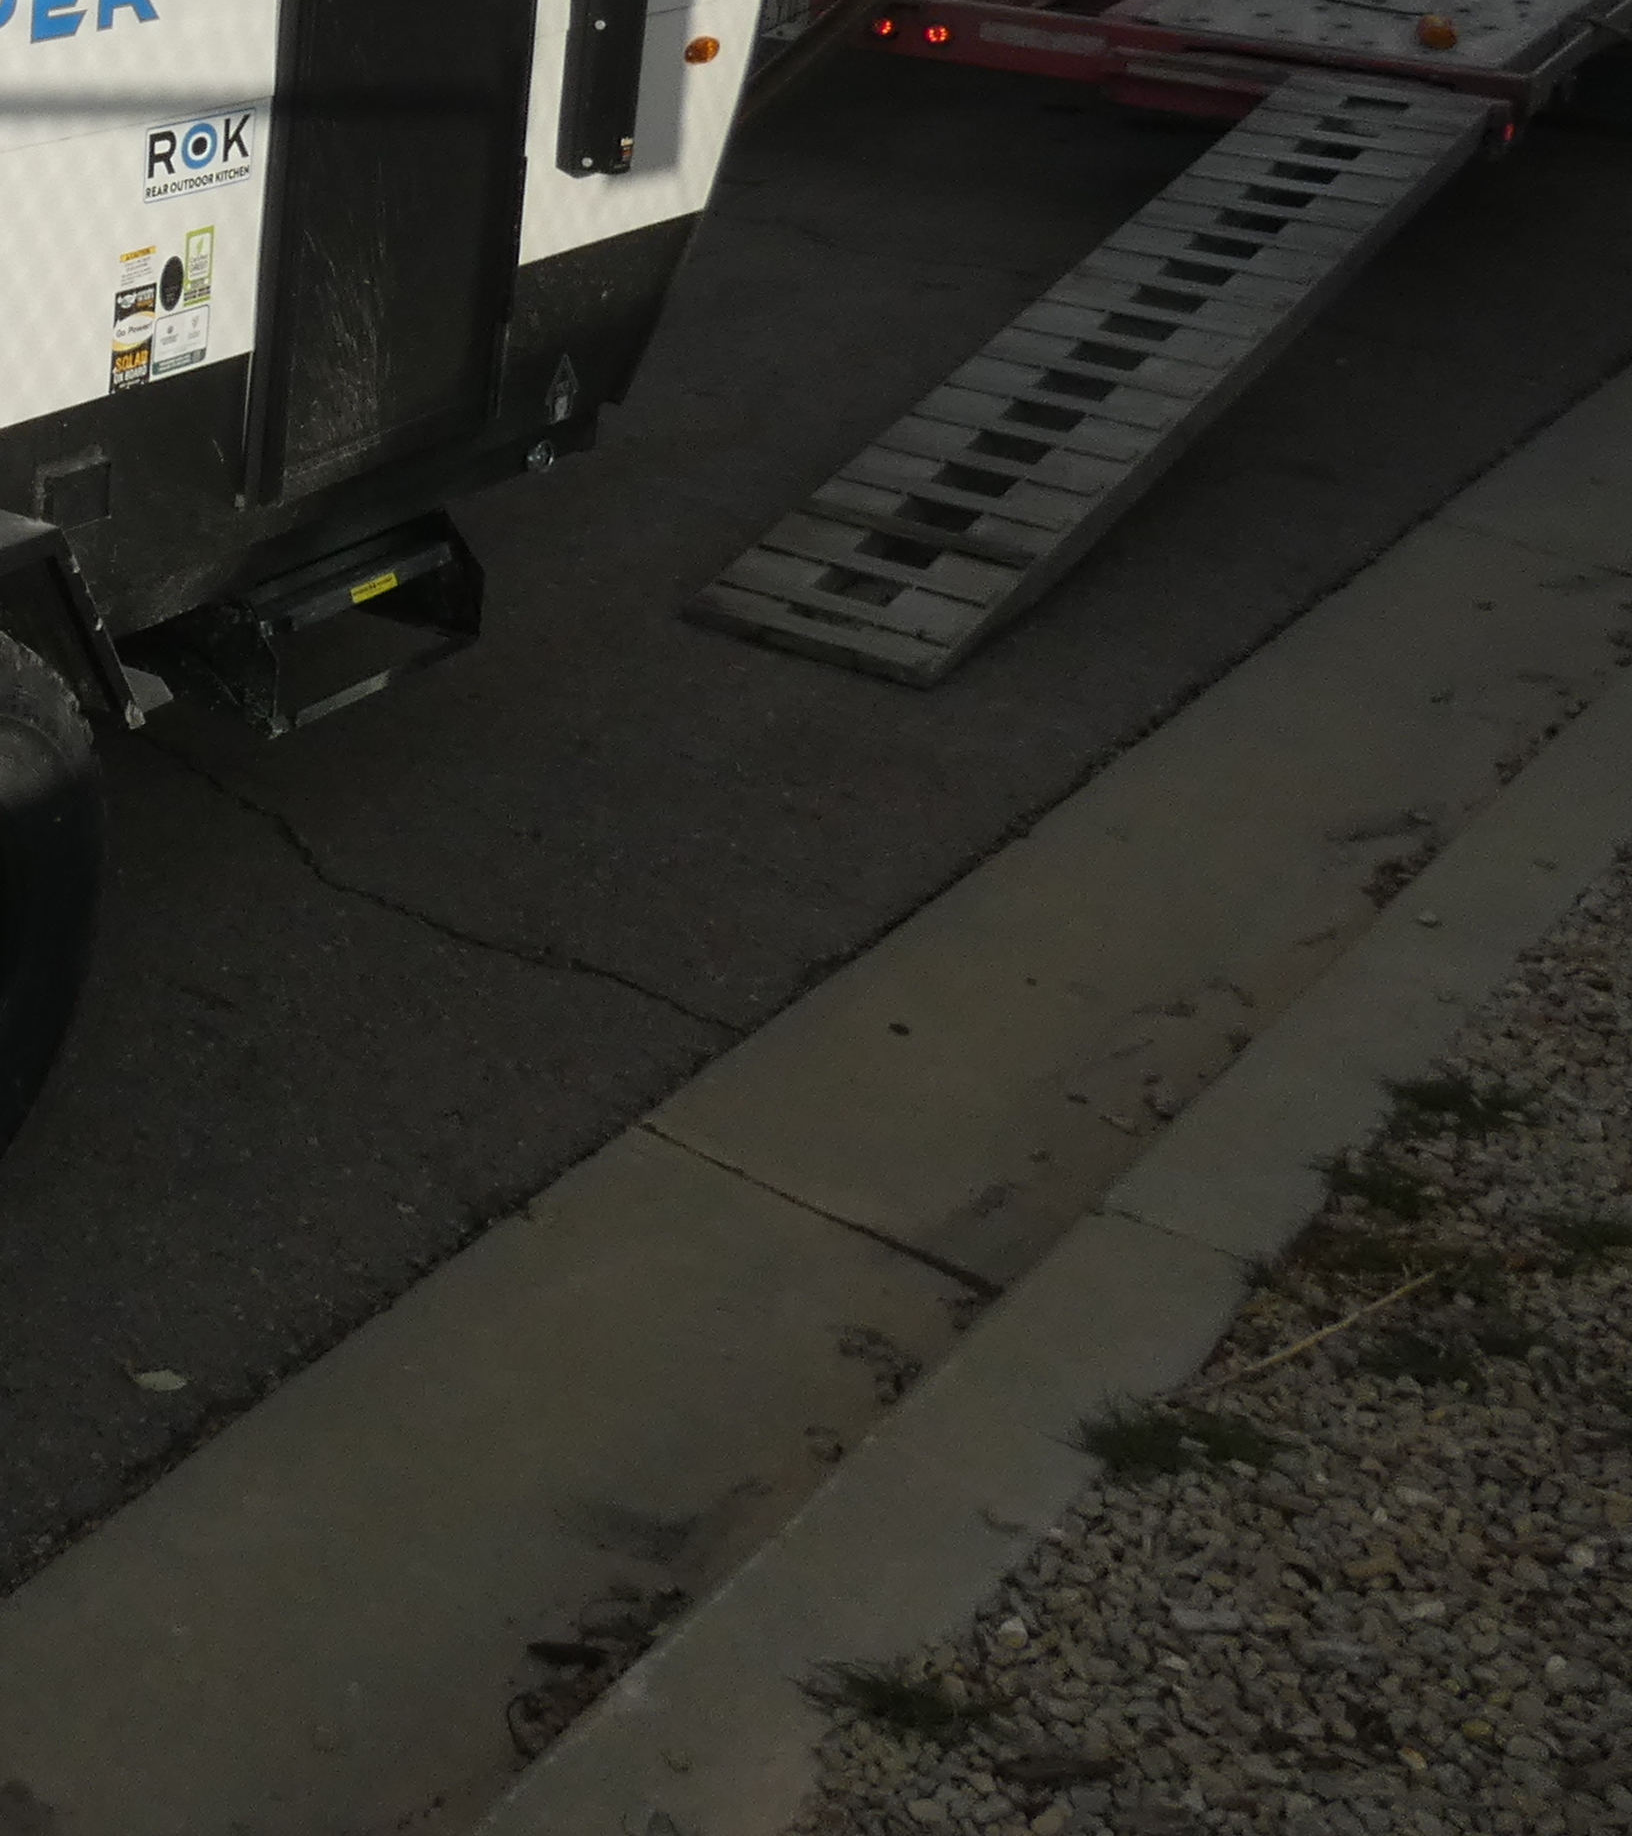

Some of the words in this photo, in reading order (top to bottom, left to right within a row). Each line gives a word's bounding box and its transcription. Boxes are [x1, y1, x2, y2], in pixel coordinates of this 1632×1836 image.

[147, 113, 251, 179] ROK
[146, 183, 168, 198] REAR
[170, 173, 213, 193] OUTDOOR
[215, 165, 250, 183] KITCHEN
[116, 350, 149, 370] SOLAR
